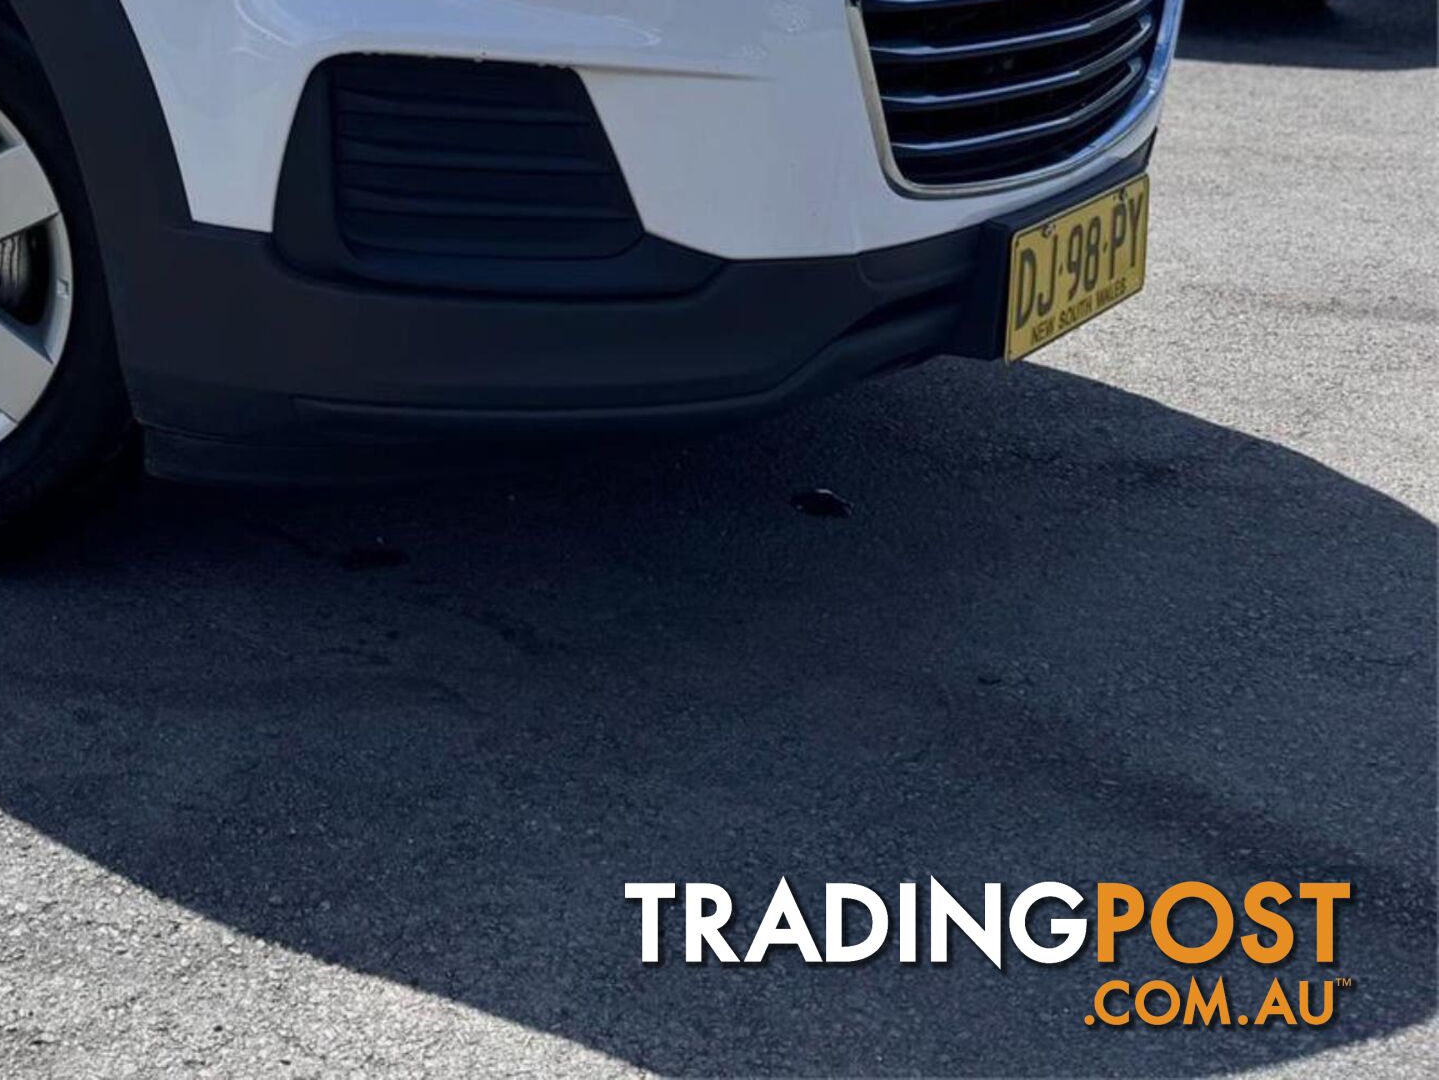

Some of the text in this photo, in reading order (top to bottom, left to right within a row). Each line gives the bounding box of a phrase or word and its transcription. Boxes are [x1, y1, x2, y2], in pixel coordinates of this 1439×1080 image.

[1031, 277, 1126, 345] NEW SOUTH WALES
